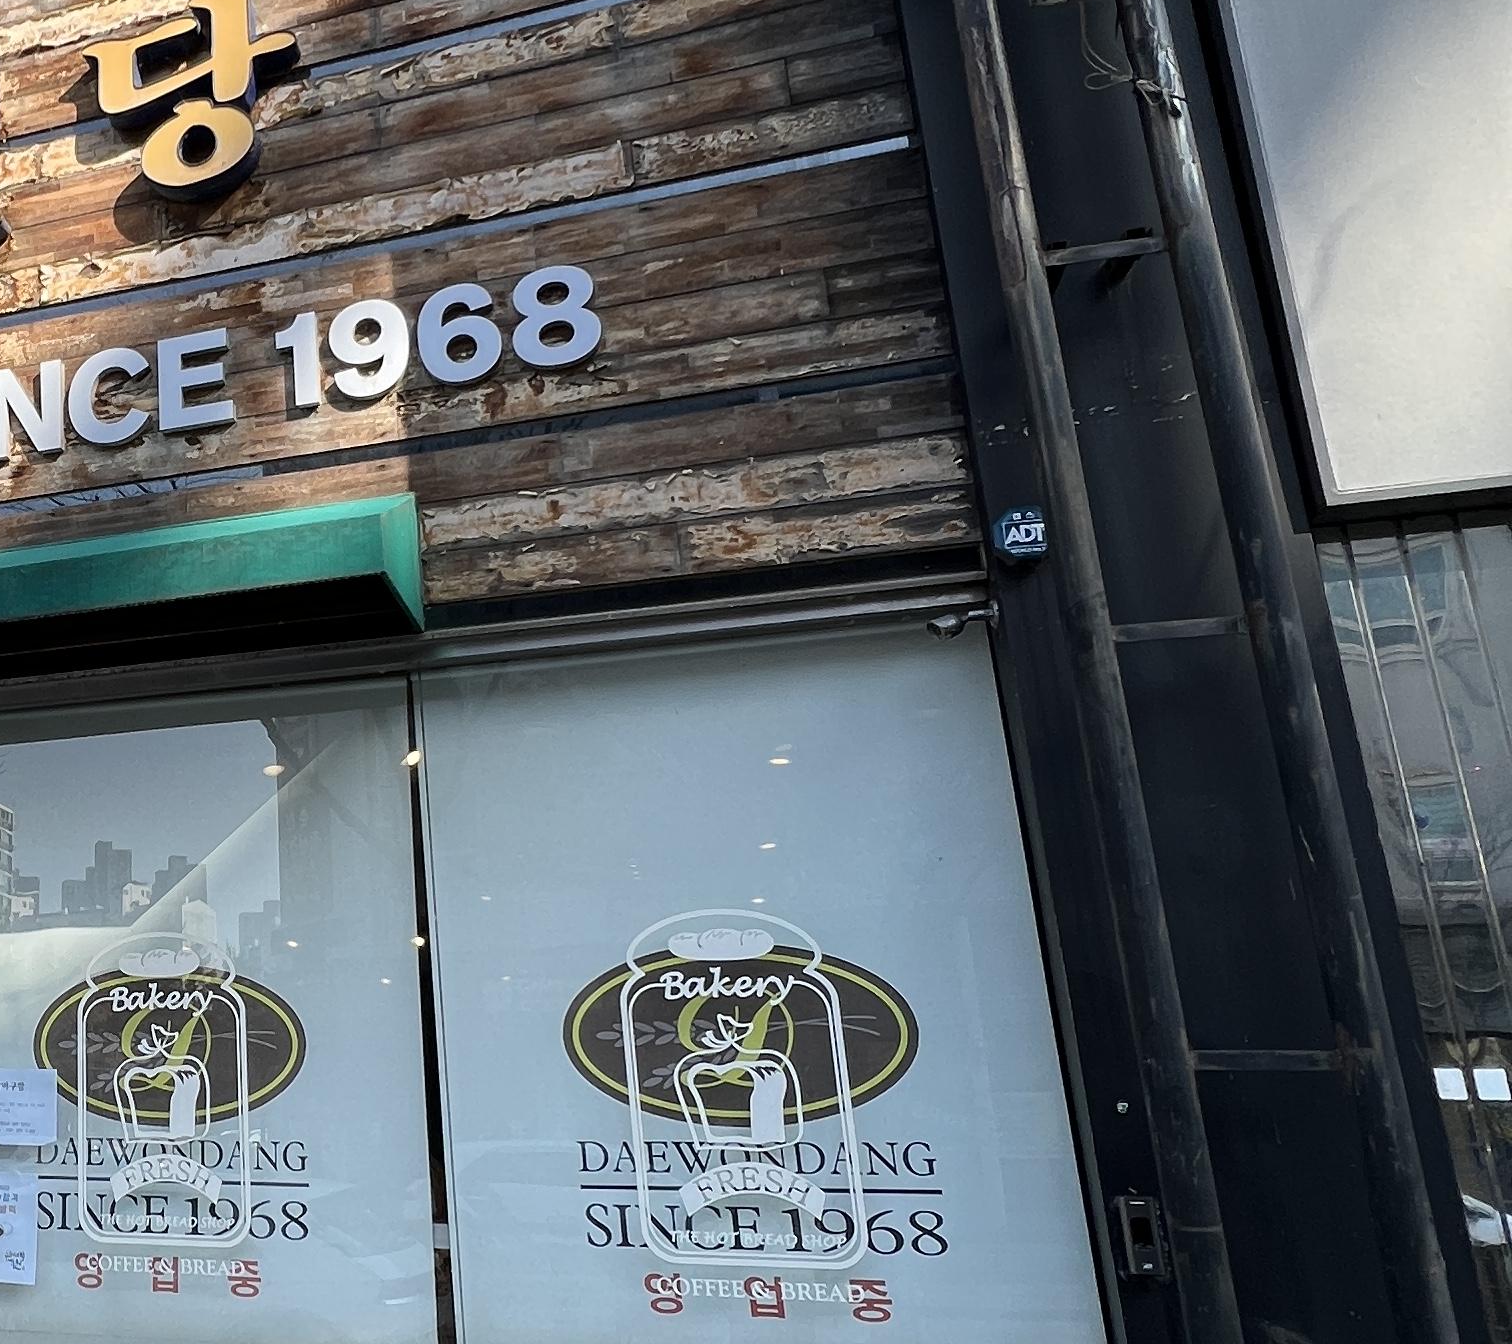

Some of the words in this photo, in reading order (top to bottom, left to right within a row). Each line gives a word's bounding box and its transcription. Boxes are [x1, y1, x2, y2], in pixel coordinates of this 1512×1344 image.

[275, 265, 603, 408] 1968
[1005, 523, 1045, 545] ADT
[109, 983, 214, 1017] Bakery
[659, 965, 794, 1006] Bakery
[120, 1157, 213, 1191] FRESH
[692, 1167, 814, 1206] FRESH
[36, 1191, 170, 1235] SINCE
[184, 1197, 310, 1241] 1968
[586, 1203, 766, 1251] SINCE
[781, 1209, 949, 1257] 1968
[86, 1256, 155, 1273] COFFEE
[157, 1257, 175, 1275] &
[180, 1258, 245, 1277] BREAD
[656, 1276, 746, 1299] COFFEE
[749, 1279, 776, 1302] &
[780, 1280, 866, 1304] BREAD
